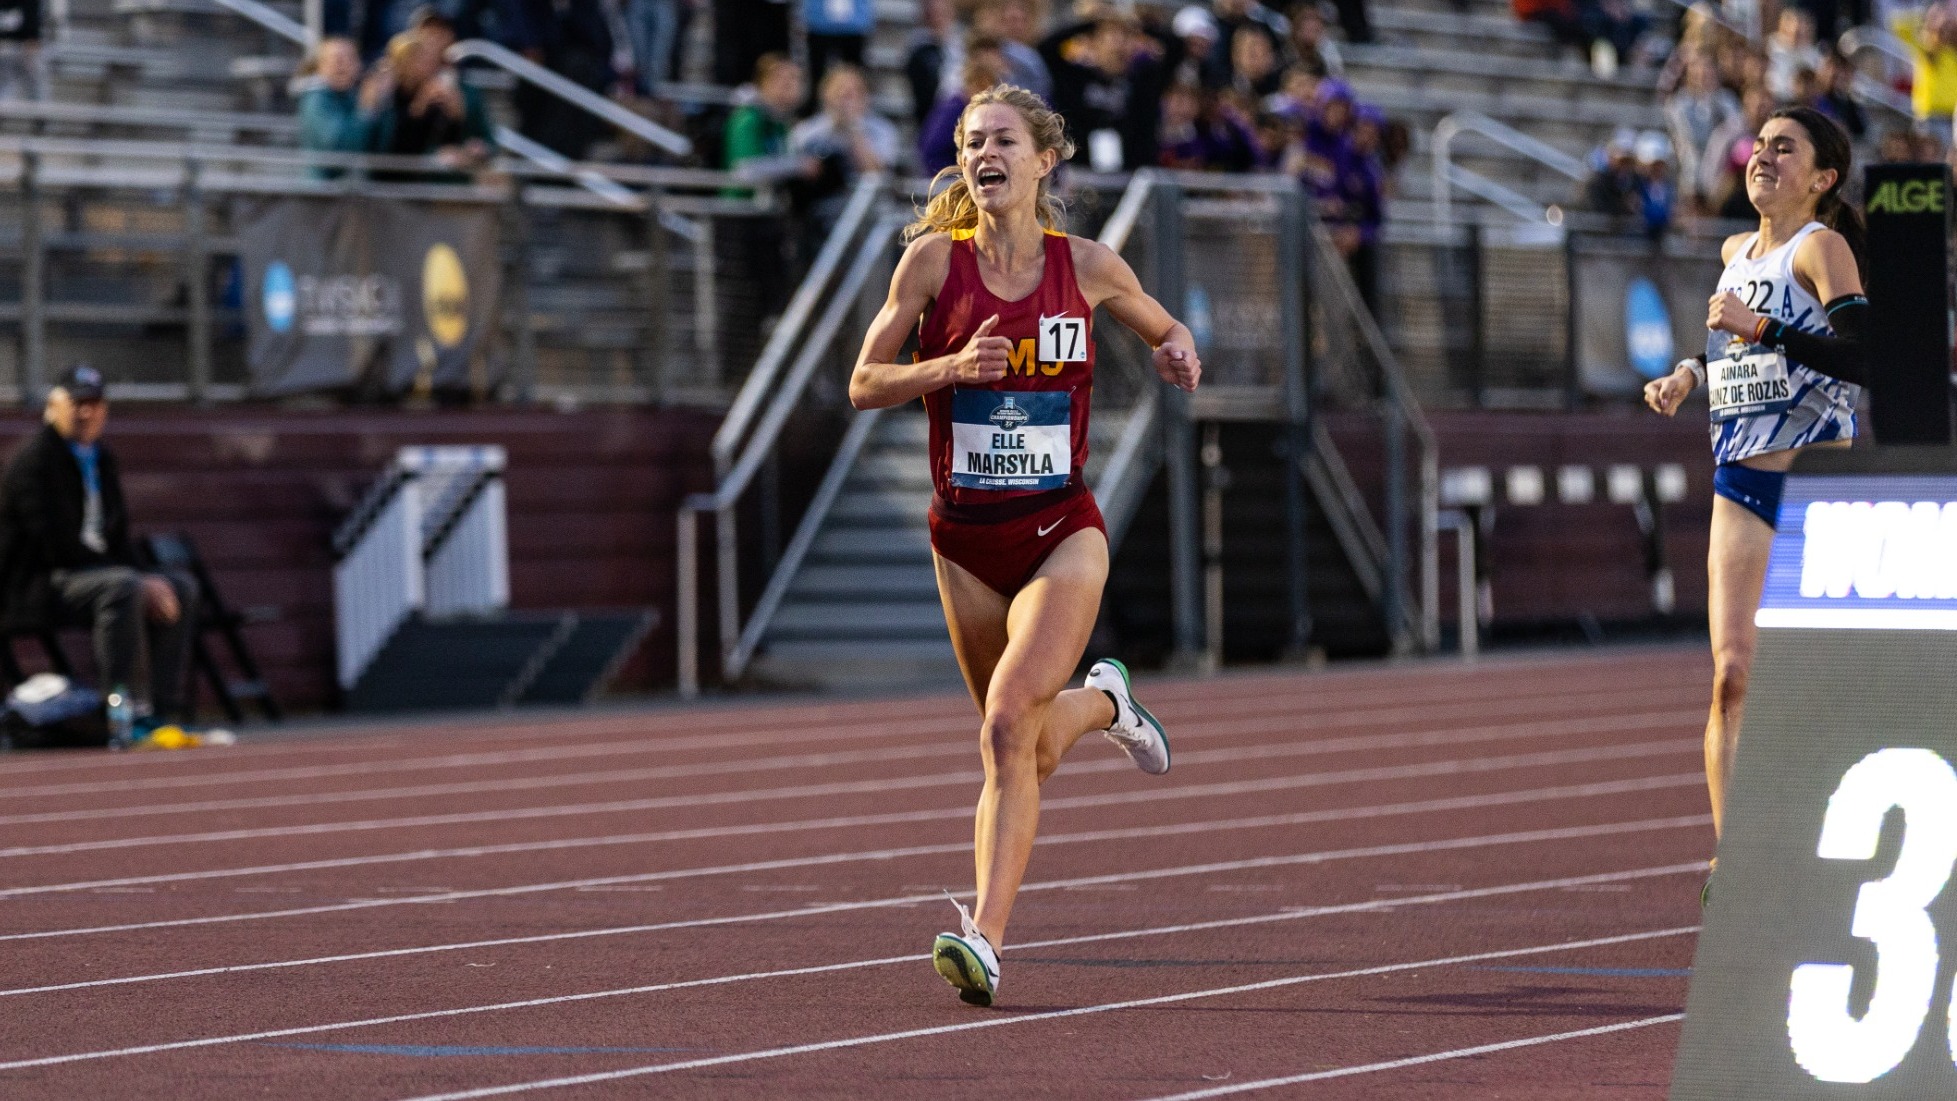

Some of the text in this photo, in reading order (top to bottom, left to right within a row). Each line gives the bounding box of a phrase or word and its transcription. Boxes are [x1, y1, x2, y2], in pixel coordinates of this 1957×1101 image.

[1866, 180, 1945, 213] ALGE
[1746, 280, 1773, 314] 22
[1048, 322, 1080, 360] 17
[1720, 363, 1758, 381] AINARA
[1730, 384, 1744, 404] DE
[1747, 379, 1789, 402] ROZAS
[992, 433, 1025, 450] ELLE
[967, 452, 1054, 475] MARSYLA
[1800, 501, 1957, 599] WOM
[1787, 747, 1957, 1084] 3
